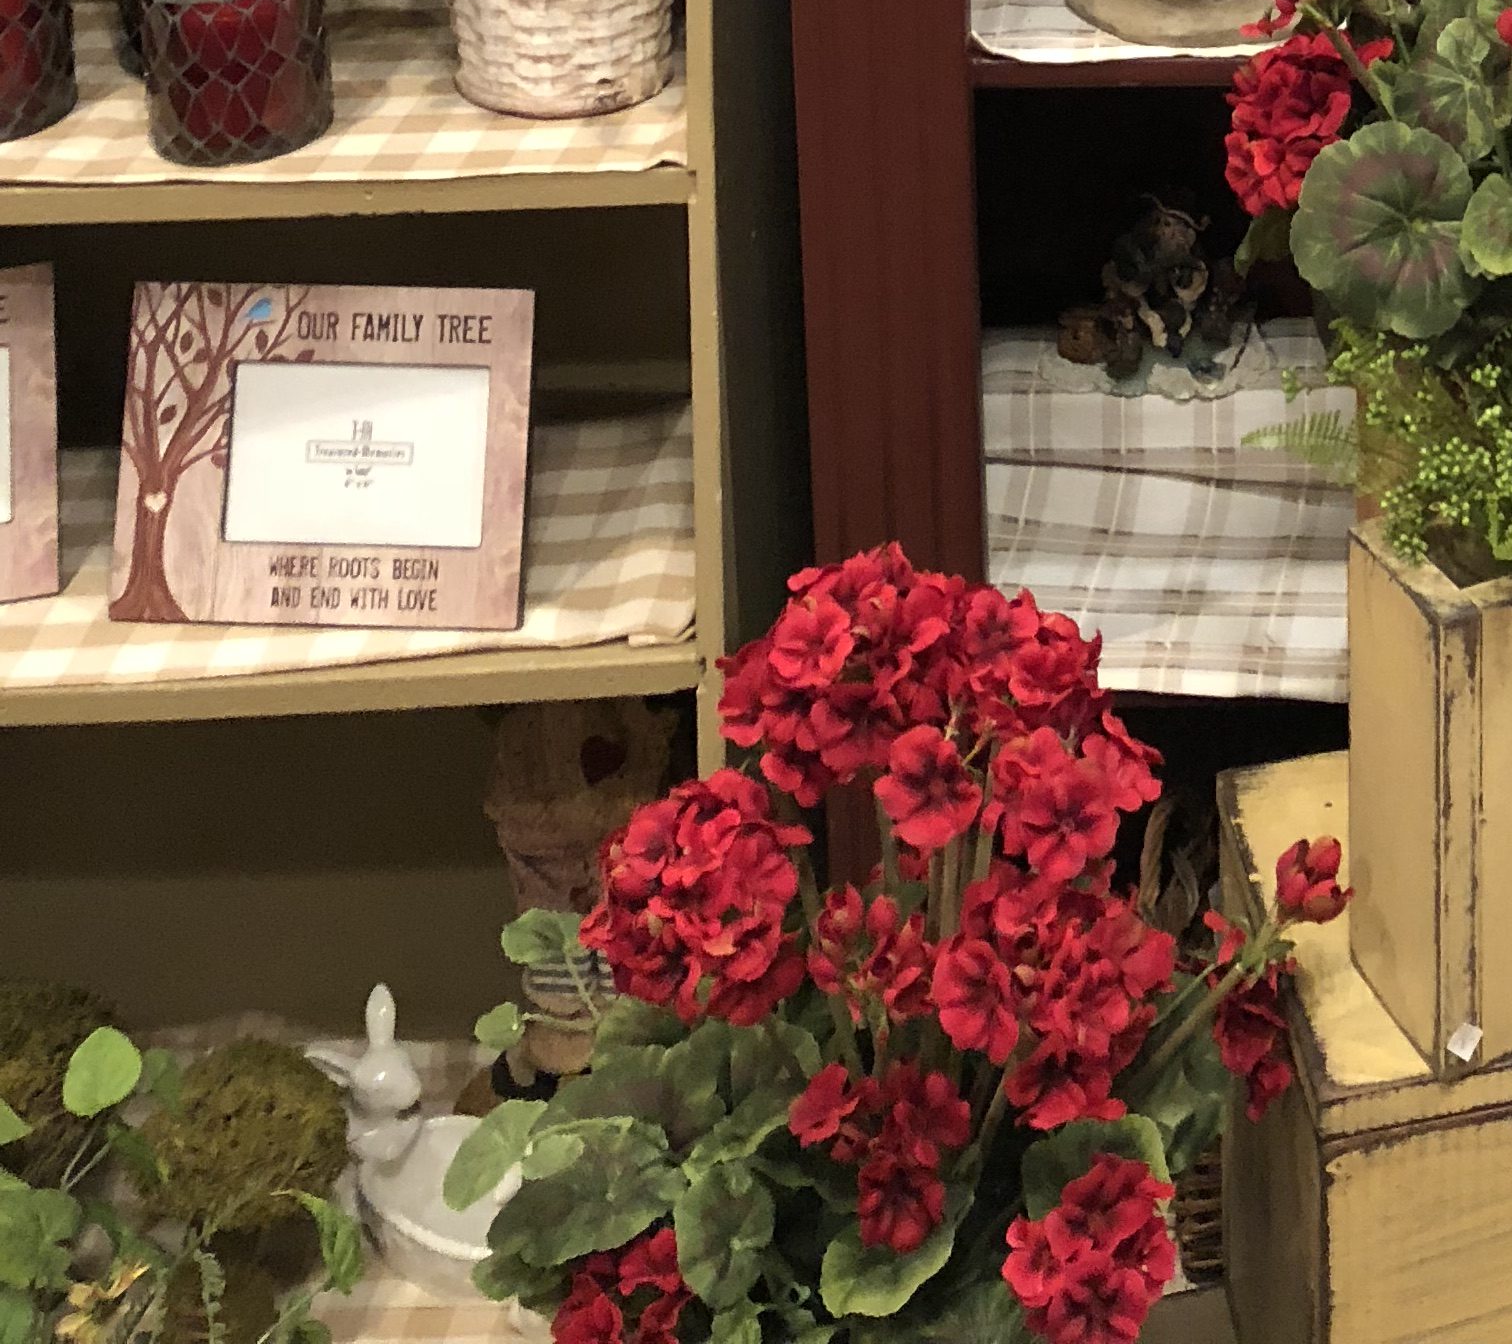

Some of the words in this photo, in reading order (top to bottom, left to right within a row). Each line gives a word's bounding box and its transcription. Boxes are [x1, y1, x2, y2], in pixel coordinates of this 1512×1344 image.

[297, 311, 340, 341] OUR
[351, 312, 424, 343] FAMILY
[437, 314, 493, 345] TREE
[269, 555, 318, 578] WHERE
[328, 556, 381, 580] ROOTS
[392, 558, 439, 581] BEGIN
[270, 586, 301, 609] AND
[310, 586, 341, 610] END
[350, 587, 389, 611] WITH
[397, 588, 438, 612] LOVE
